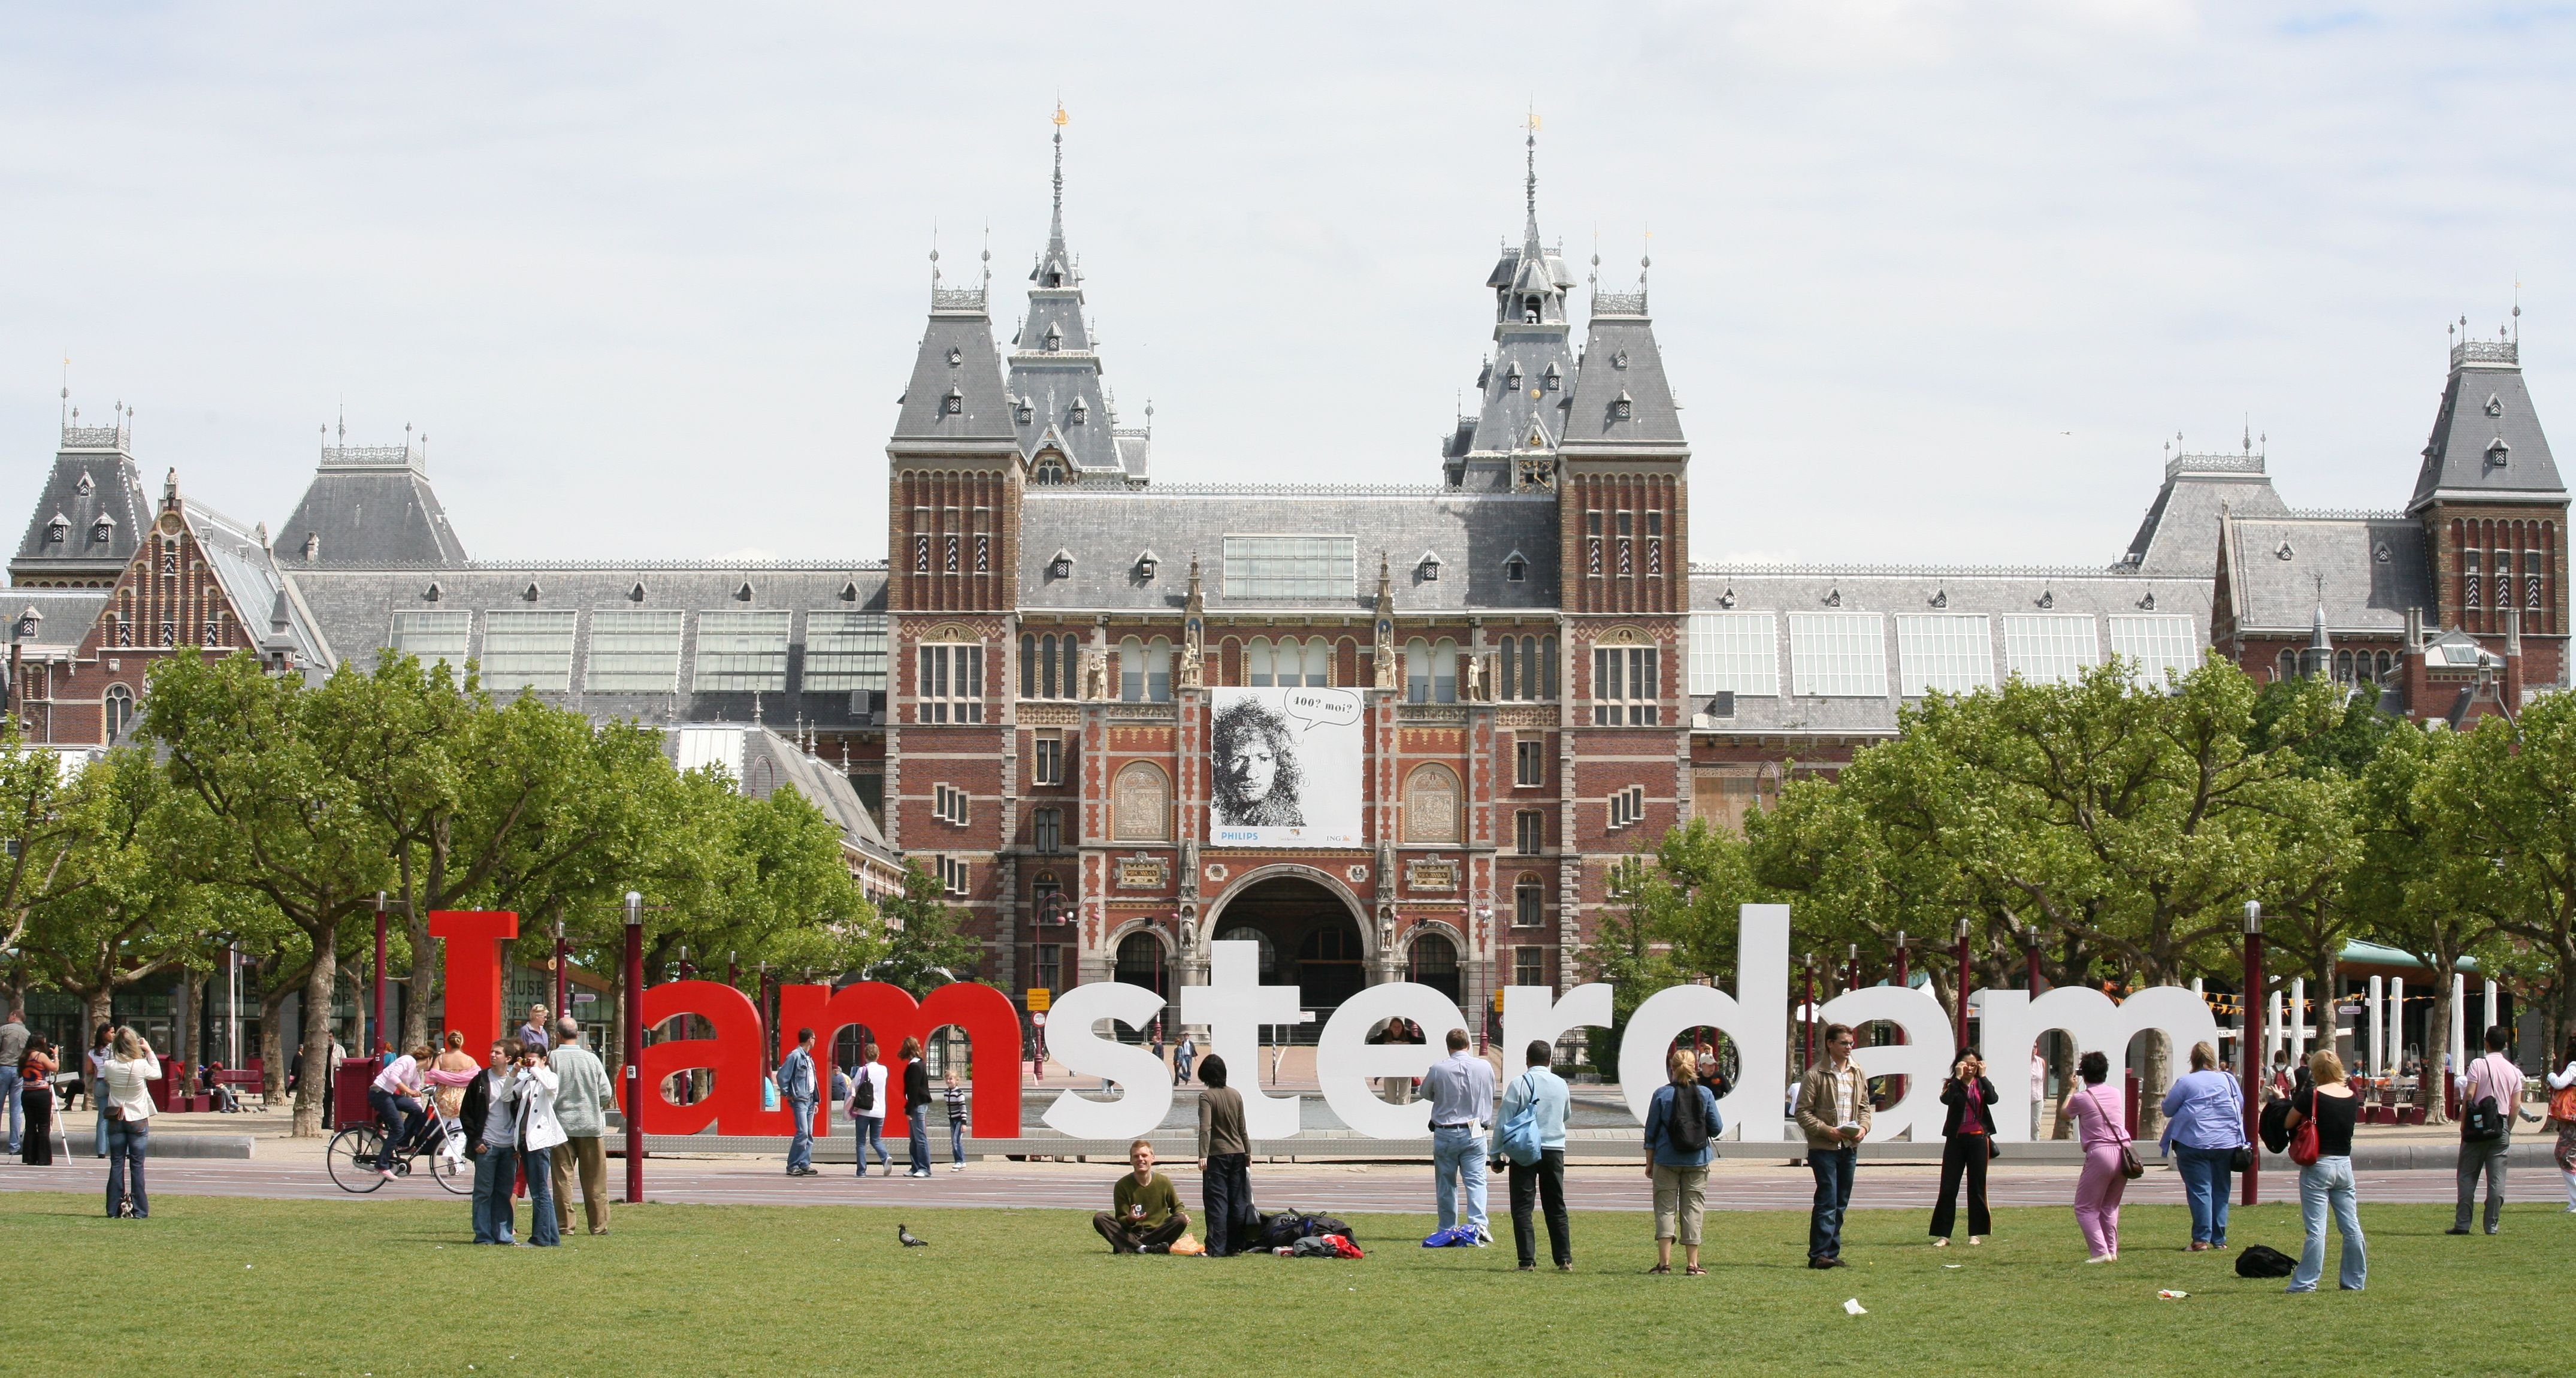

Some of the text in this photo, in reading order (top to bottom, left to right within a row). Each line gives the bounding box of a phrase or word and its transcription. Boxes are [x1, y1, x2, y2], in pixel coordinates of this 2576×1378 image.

[1293, 696, 1352, 714] 400? moi?
[1221, 832, 1258, 840] PHILIPS
[429, 903, 2220, 1143] I amsterdam
